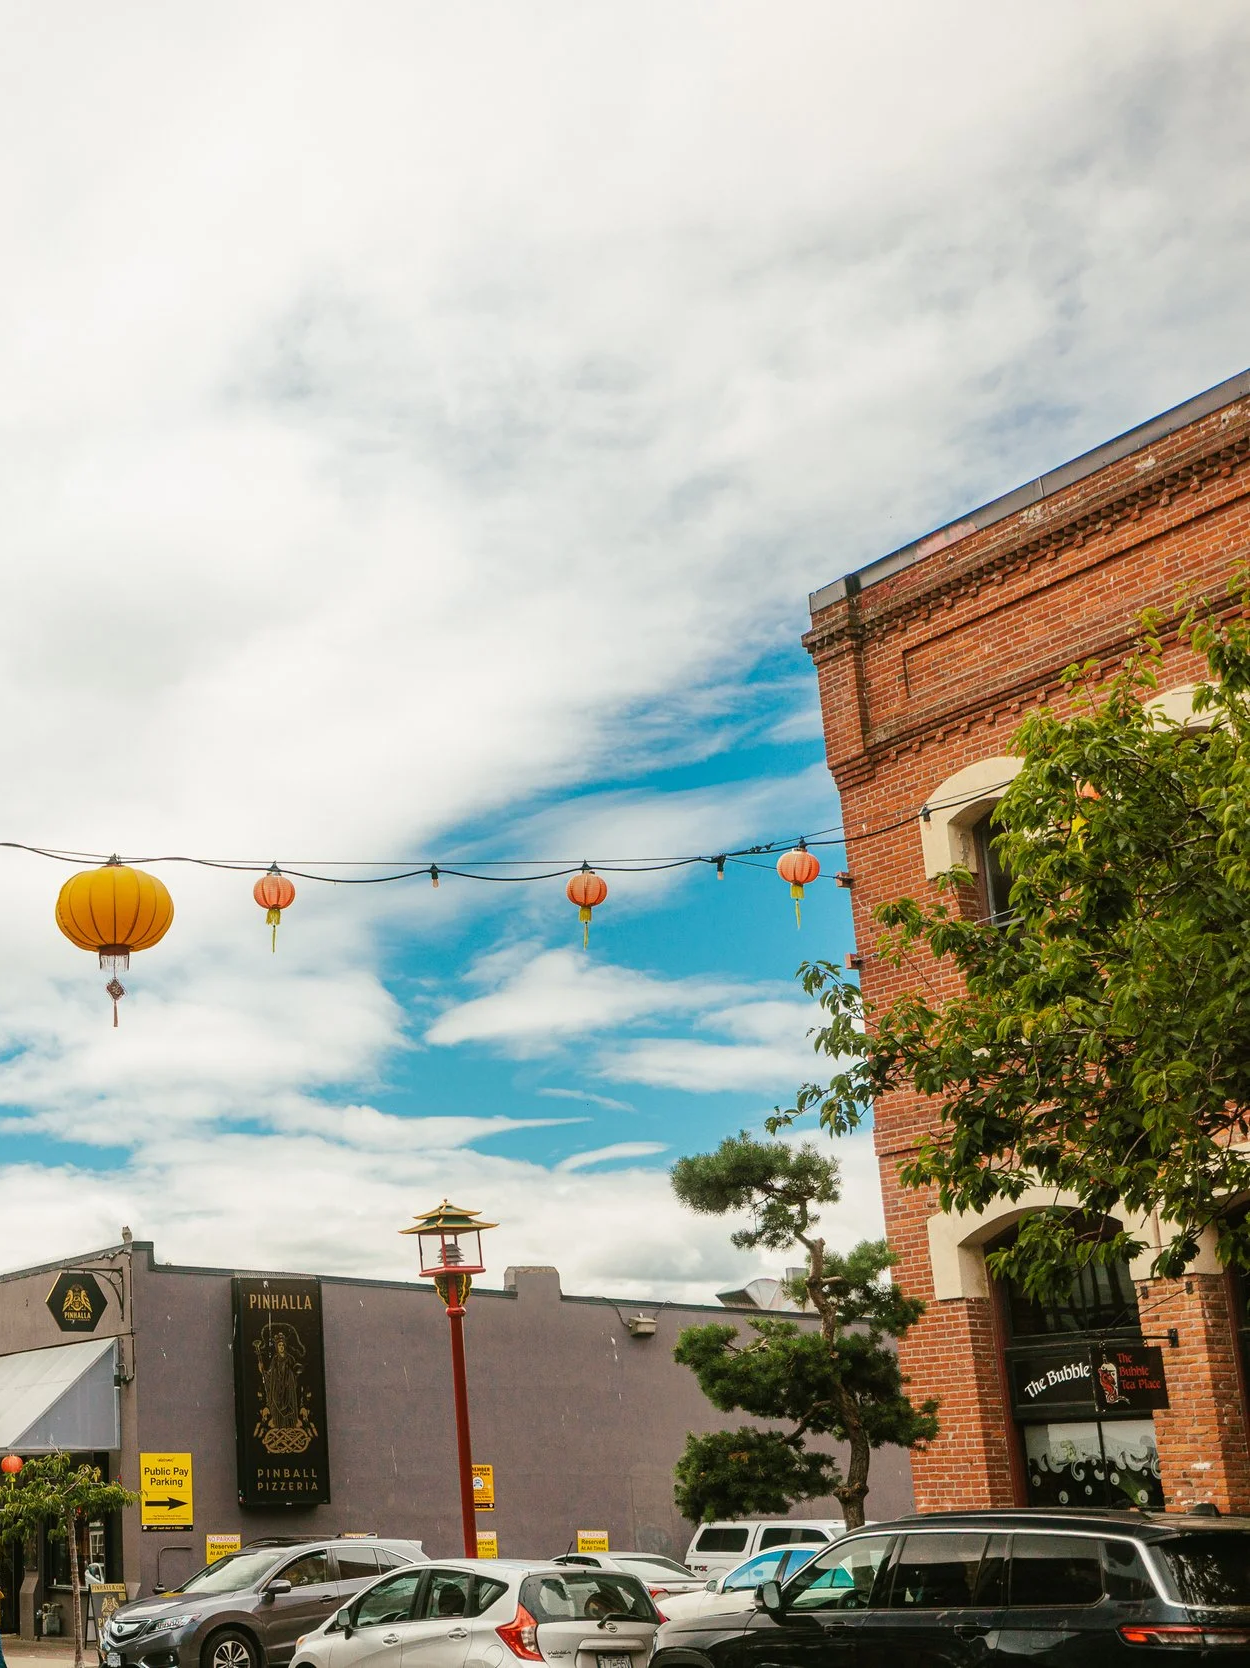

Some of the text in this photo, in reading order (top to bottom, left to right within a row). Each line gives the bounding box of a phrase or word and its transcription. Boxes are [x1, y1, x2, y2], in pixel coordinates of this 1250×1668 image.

[249, 1294, 312, 1310] PINHALLA
[64, 1311, 91, 1319] PINHALLA
[1117, 1353, 1132, 1363] The
[1119, 1366, 1149, 1377] Bubble
[1024, 1362, 1091, 1398] The Bubble
[1121, 1379, 1161, 1390] Tea Place
[144, 1467, 189, 1477] Public Pay
[257, 1468, 318, 1478] PINBALL
[150, 1477, 183, 1488] Parking
[257, 1481, 319, 1491] PIZZERIA
